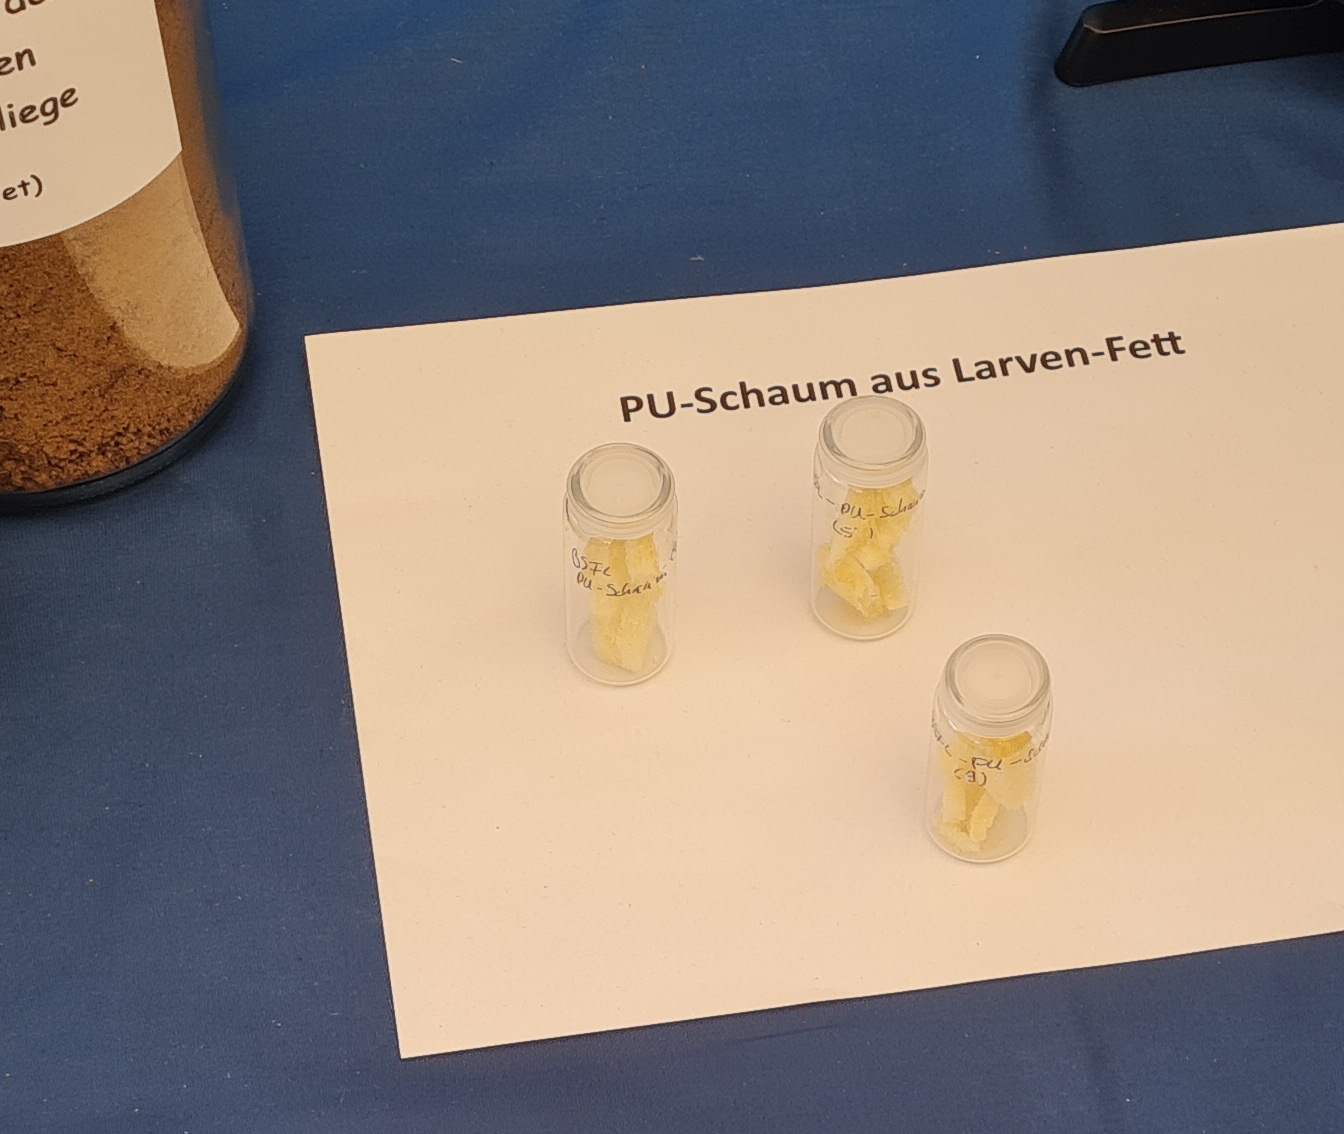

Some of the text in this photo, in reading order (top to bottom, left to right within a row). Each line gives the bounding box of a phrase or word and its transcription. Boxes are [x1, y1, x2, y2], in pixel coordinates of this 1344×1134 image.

[619, 330, 1187, 423] PU-Schaum aus Larven-Fett
